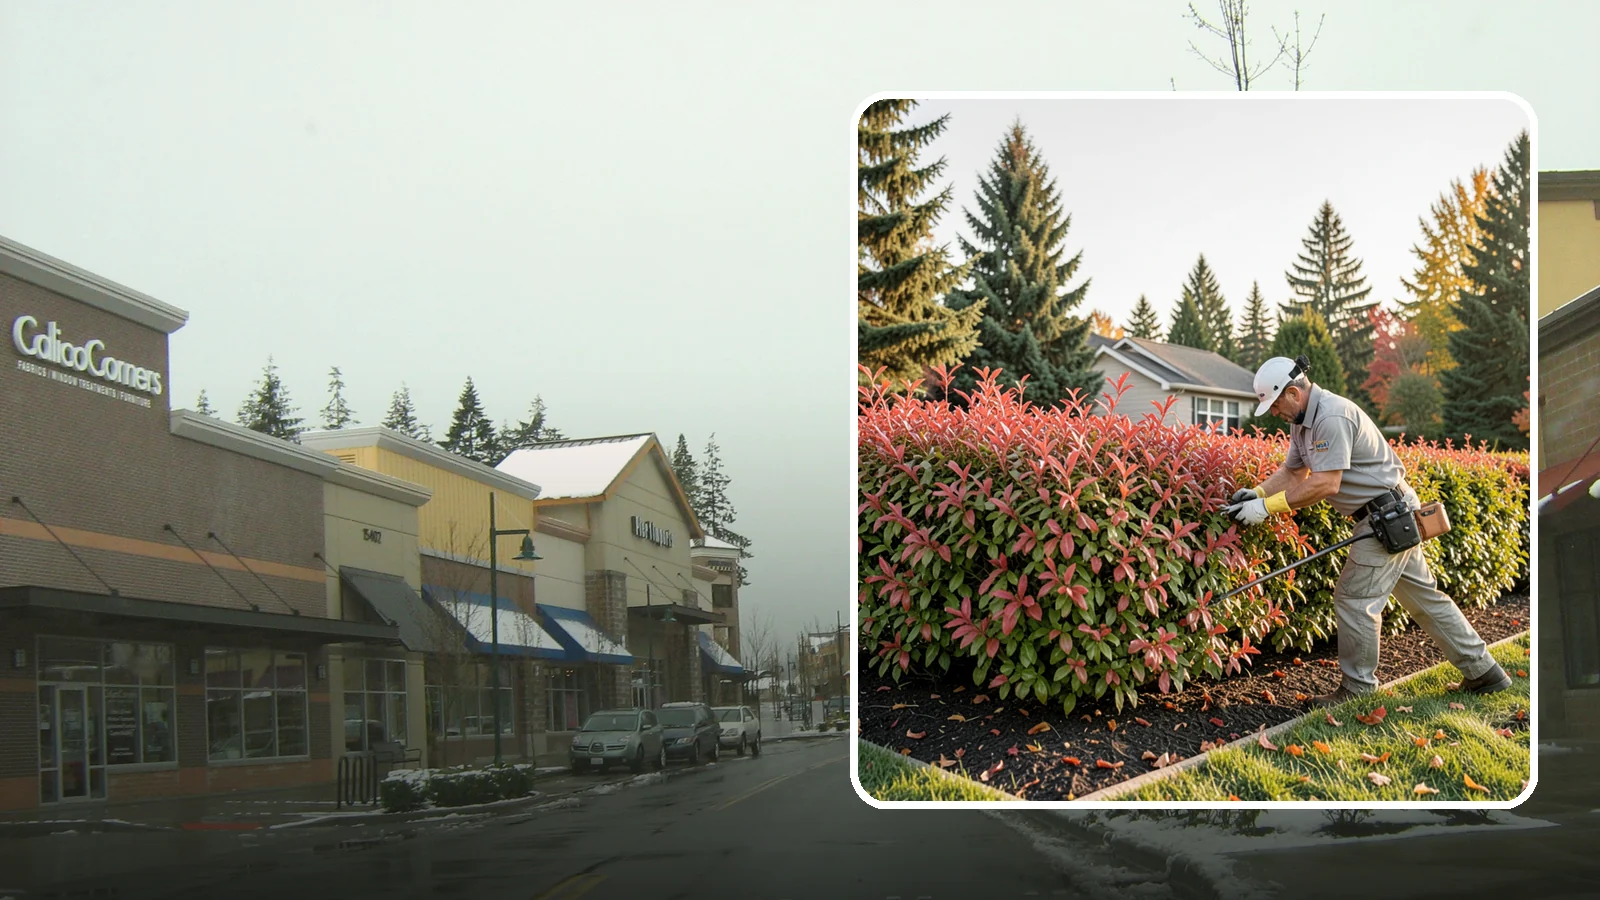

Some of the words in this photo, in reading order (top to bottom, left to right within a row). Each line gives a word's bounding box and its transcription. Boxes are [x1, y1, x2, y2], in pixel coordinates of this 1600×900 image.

[17, 360, 47, 377] FABRICS
[51, 370, 78, 387] WINDOW
[79, 379, 117, 399] TREATMENTS
[120, 391, 151, 409] FURNITURE
